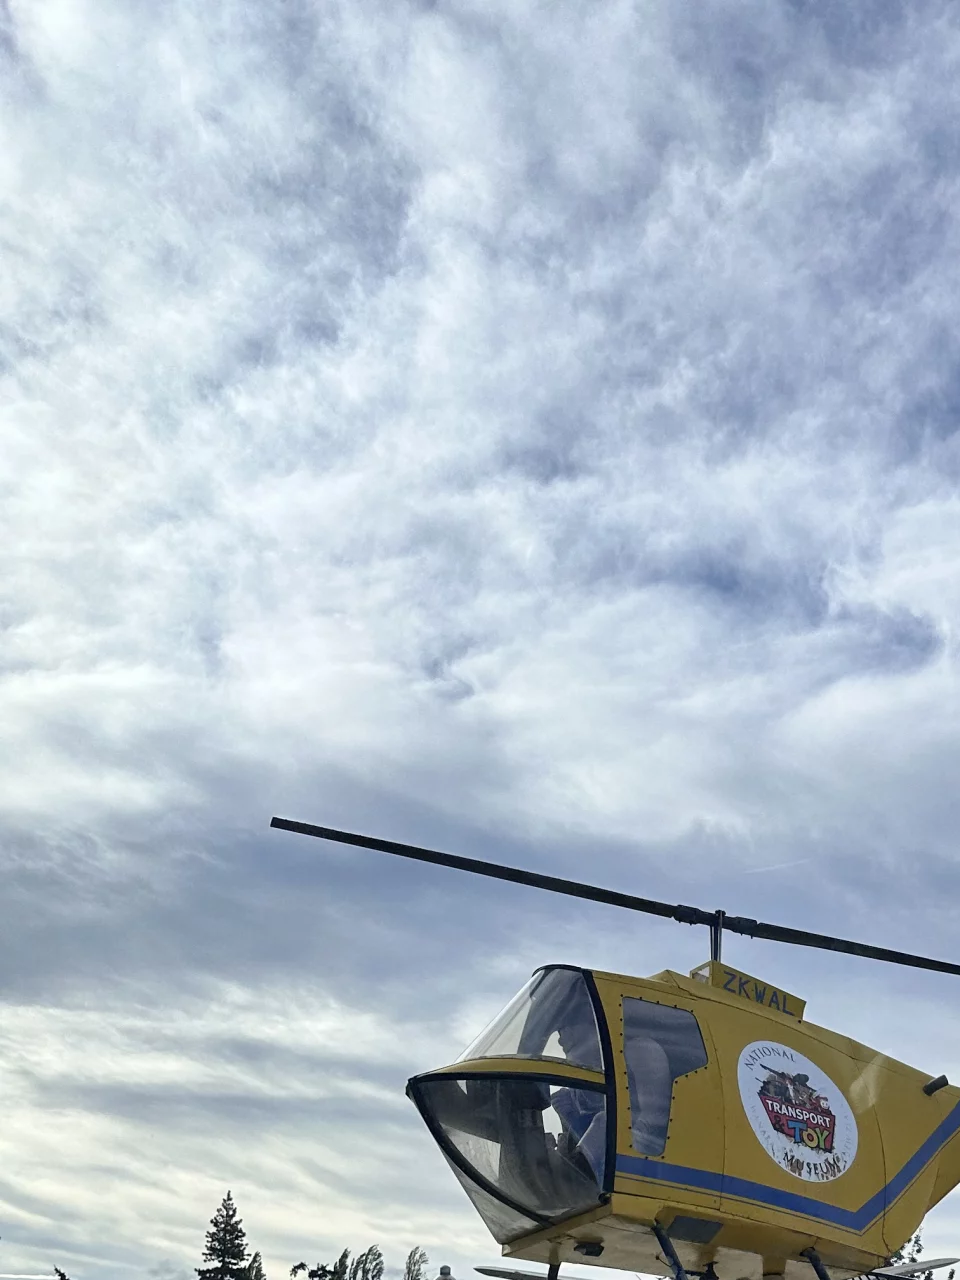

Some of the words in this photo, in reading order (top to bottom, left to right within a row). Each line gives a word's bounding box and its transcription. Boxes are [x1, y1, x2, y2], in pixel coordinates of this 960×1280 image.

[744, 1046, 796, 1071] NATIONAL
[765, 1099, 831, 1128] TRANSPORT
[786, 1120, 830, 1150] TOY
[783, 1151, 842, 1176] MUSEUM
